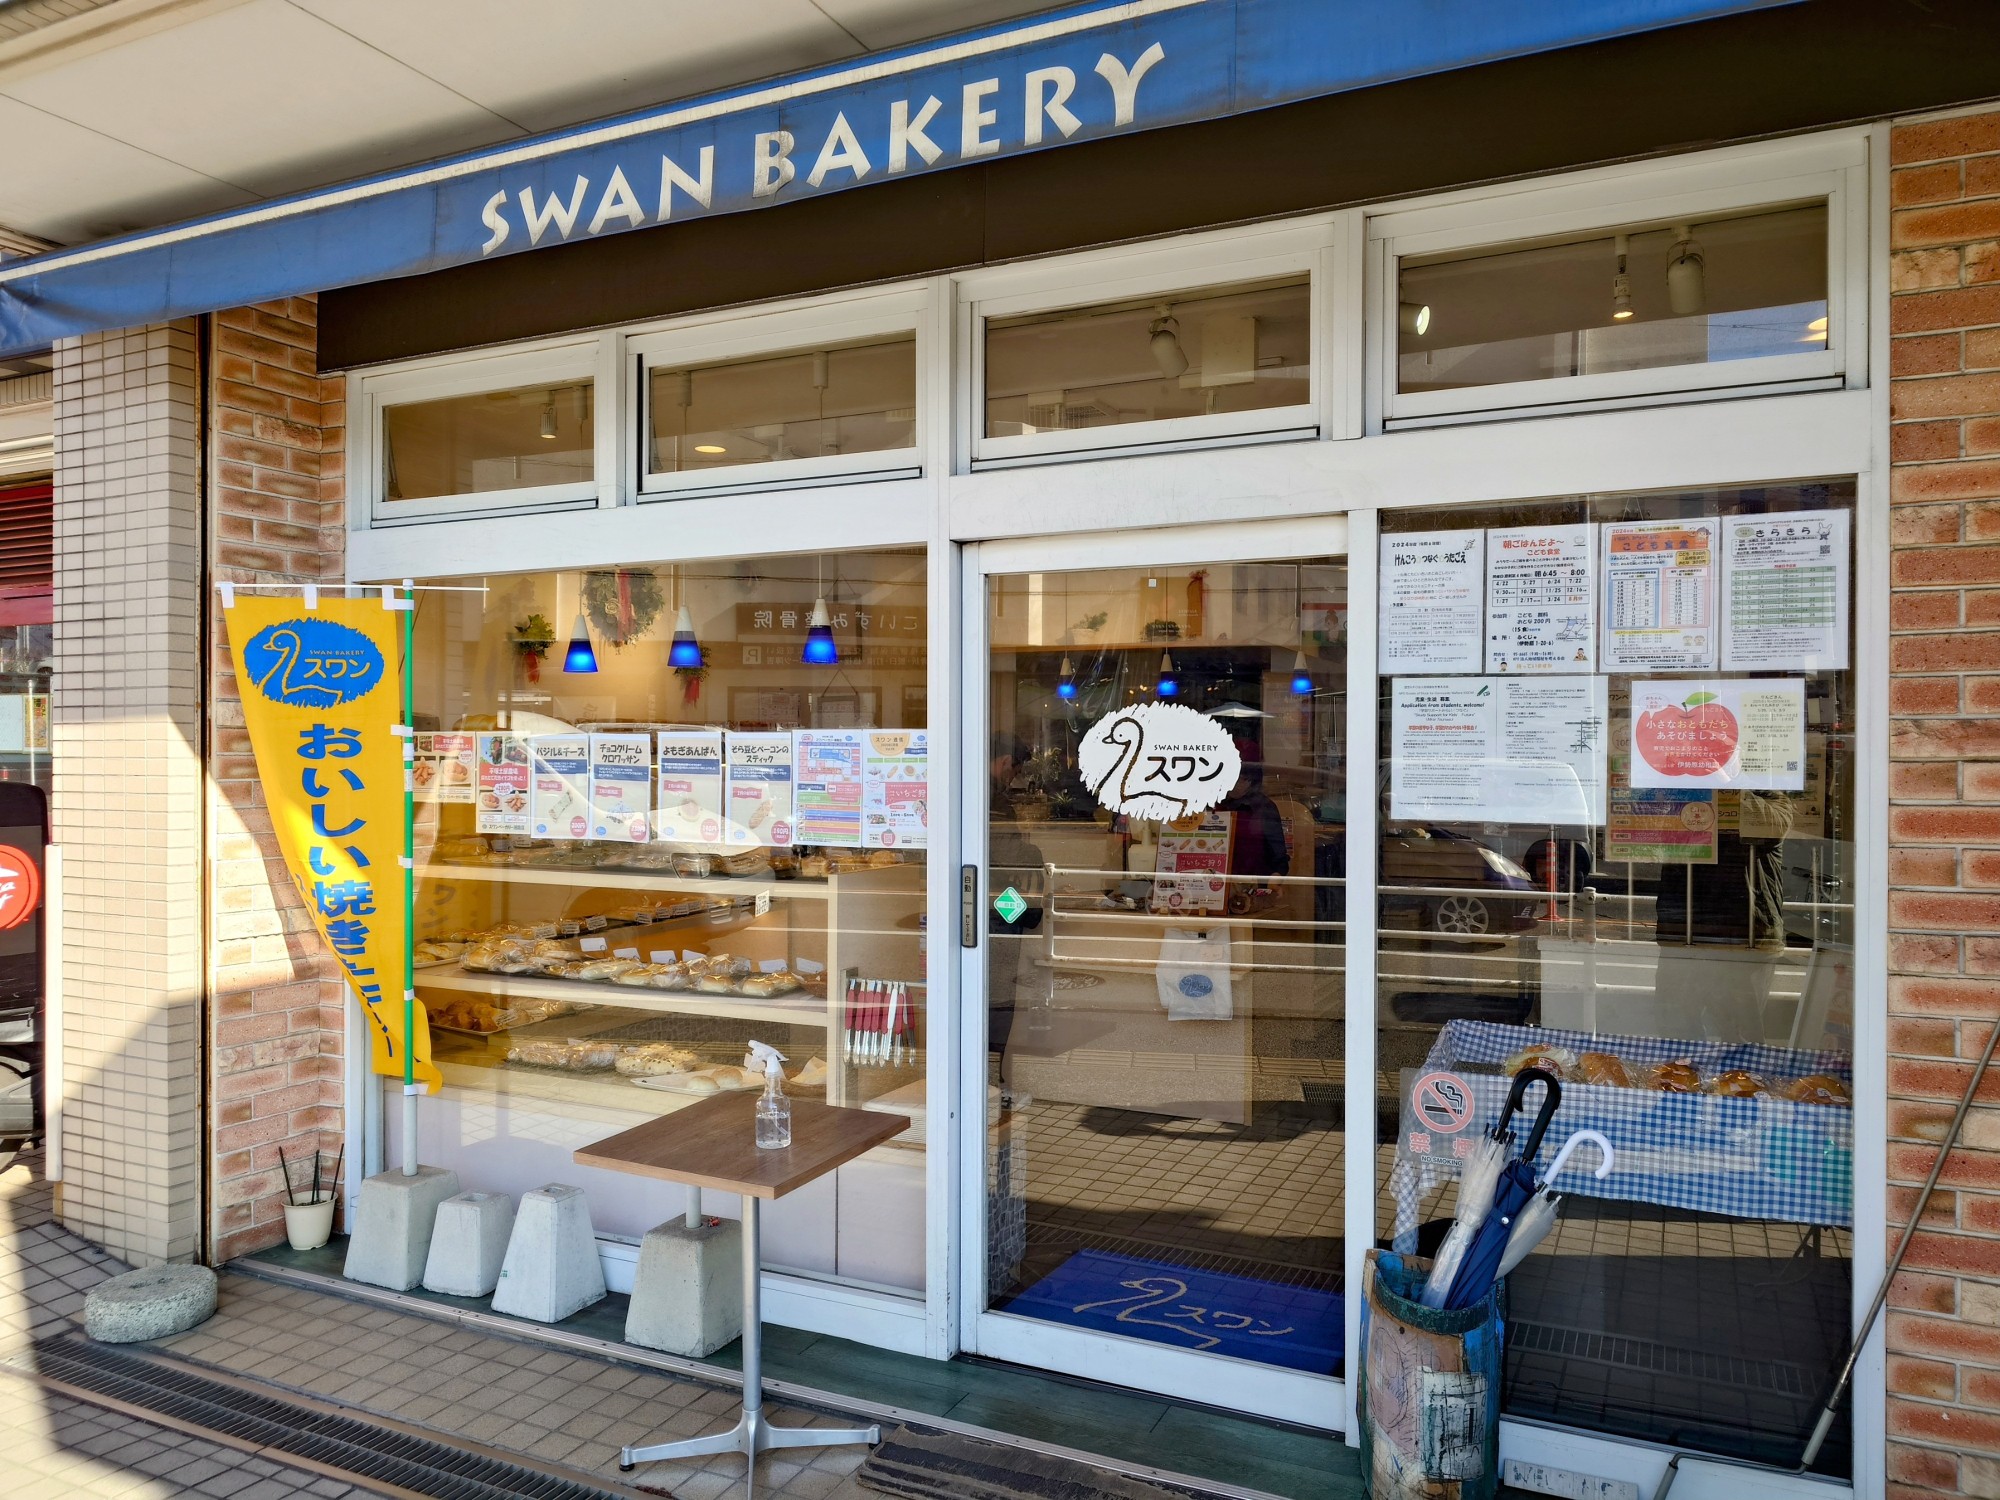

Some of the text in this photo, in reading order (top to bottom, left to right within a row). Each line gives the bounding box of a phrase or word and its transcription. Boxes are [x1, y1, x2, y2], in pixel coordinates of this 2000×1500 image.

[482, 41, 1165, 257] SWAN BAKERY
[1755, 526, 1811, 538] きらきら
[303, 658, 371, 679] スワン
[1646, 719, 1729, 729] 小さなおともだち
[1656, 730, 1728, 741] あそびましょう
[600, 743, 642, 754] チョコクリーム
[663, 746, 717, 756] よもぎあんぱん
[732, 745, 789, 754] そら豆とベーコンの
[1154, 744, 1219, 752] SWAN BAKERY
[602, 754, 640, 764] クロワッサン
[746, 755, 774, 763] スティック
[1145, 756, 1224, 783] スワン
[964, 876, 972, 893] 自動
[1420, 1154, 1463, 1167] NO SMOKING
[1164, 1304, 1295, 1336] スワン
